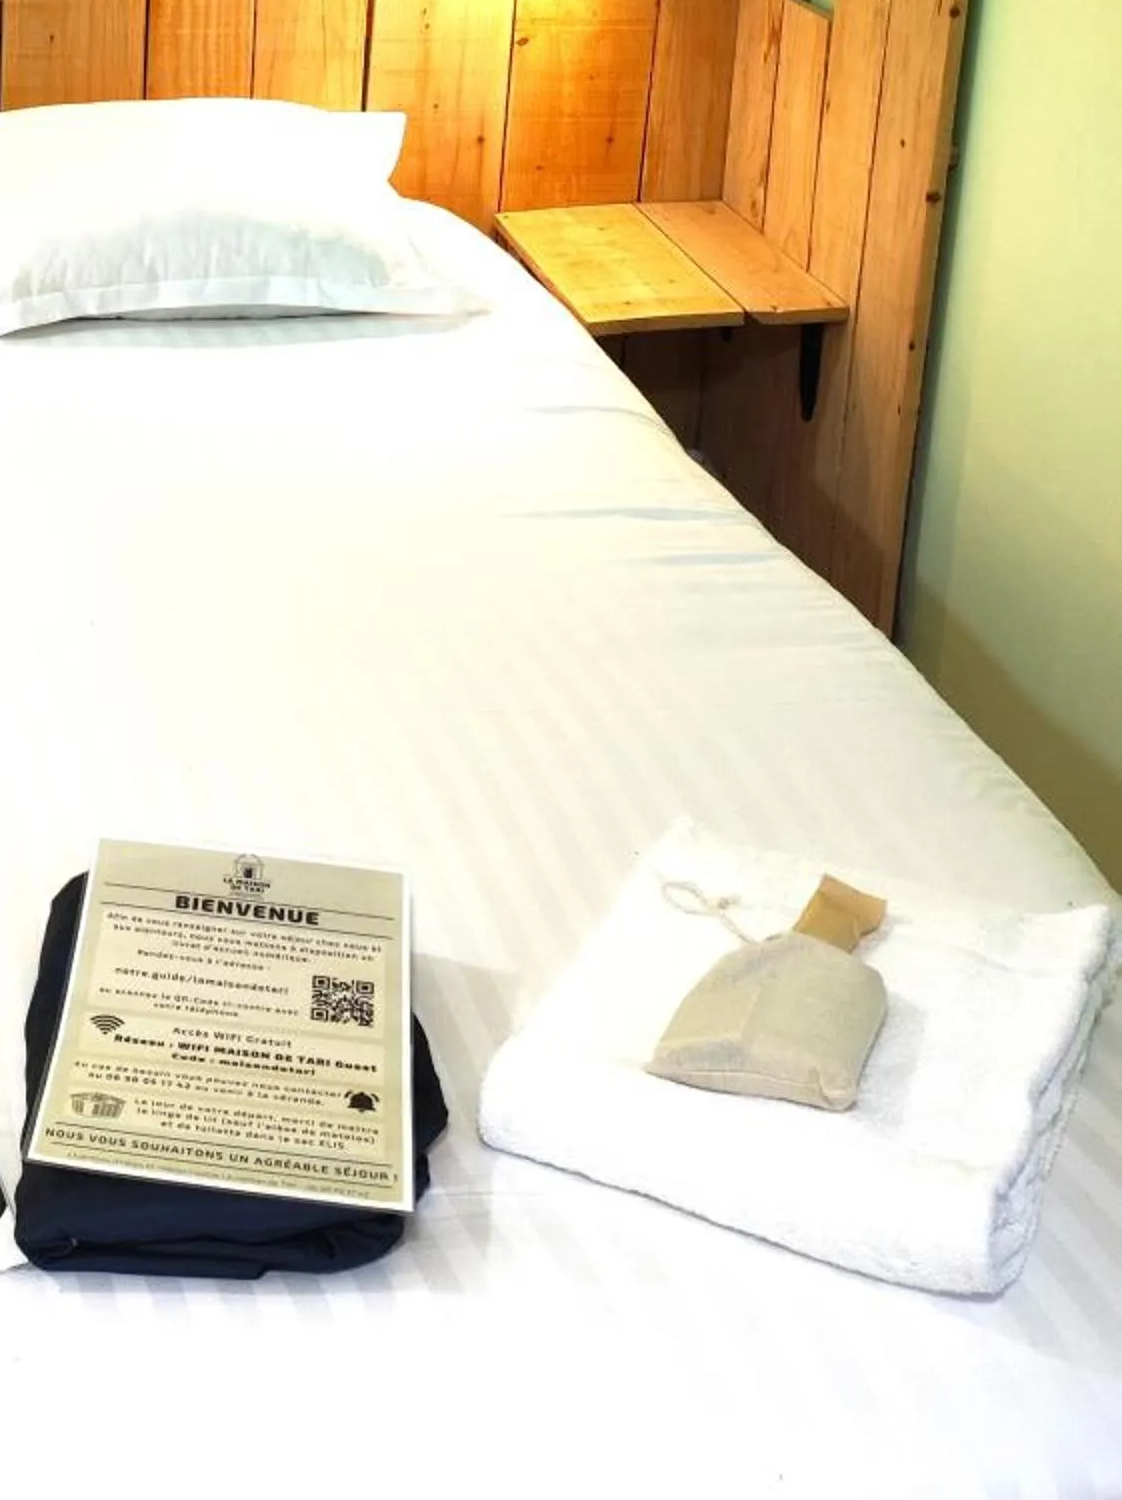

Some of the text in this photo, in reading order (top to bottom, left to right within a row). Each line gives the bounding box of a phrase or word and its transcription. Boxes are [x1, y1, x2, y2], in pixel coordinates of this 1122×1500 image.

[175, 896, 320, 925] BIENVENUE
[245, 1035, 291, 1048] Gratuit
[213, 1045, 269, 1060] MAISON
[274, 1052, 293, 1063] DE
[44, 1127, 84, 1142] NOUS
[89, 1133, 127, 1147] VOUS
[130, 1138, 223, 1160] SOUHAITONS
[229, 1151, 249, 1164] UN
[253, 1154, 328, 1174] AGRÉABLE
[334, 1164, 388, 1182] SÉJOUR
